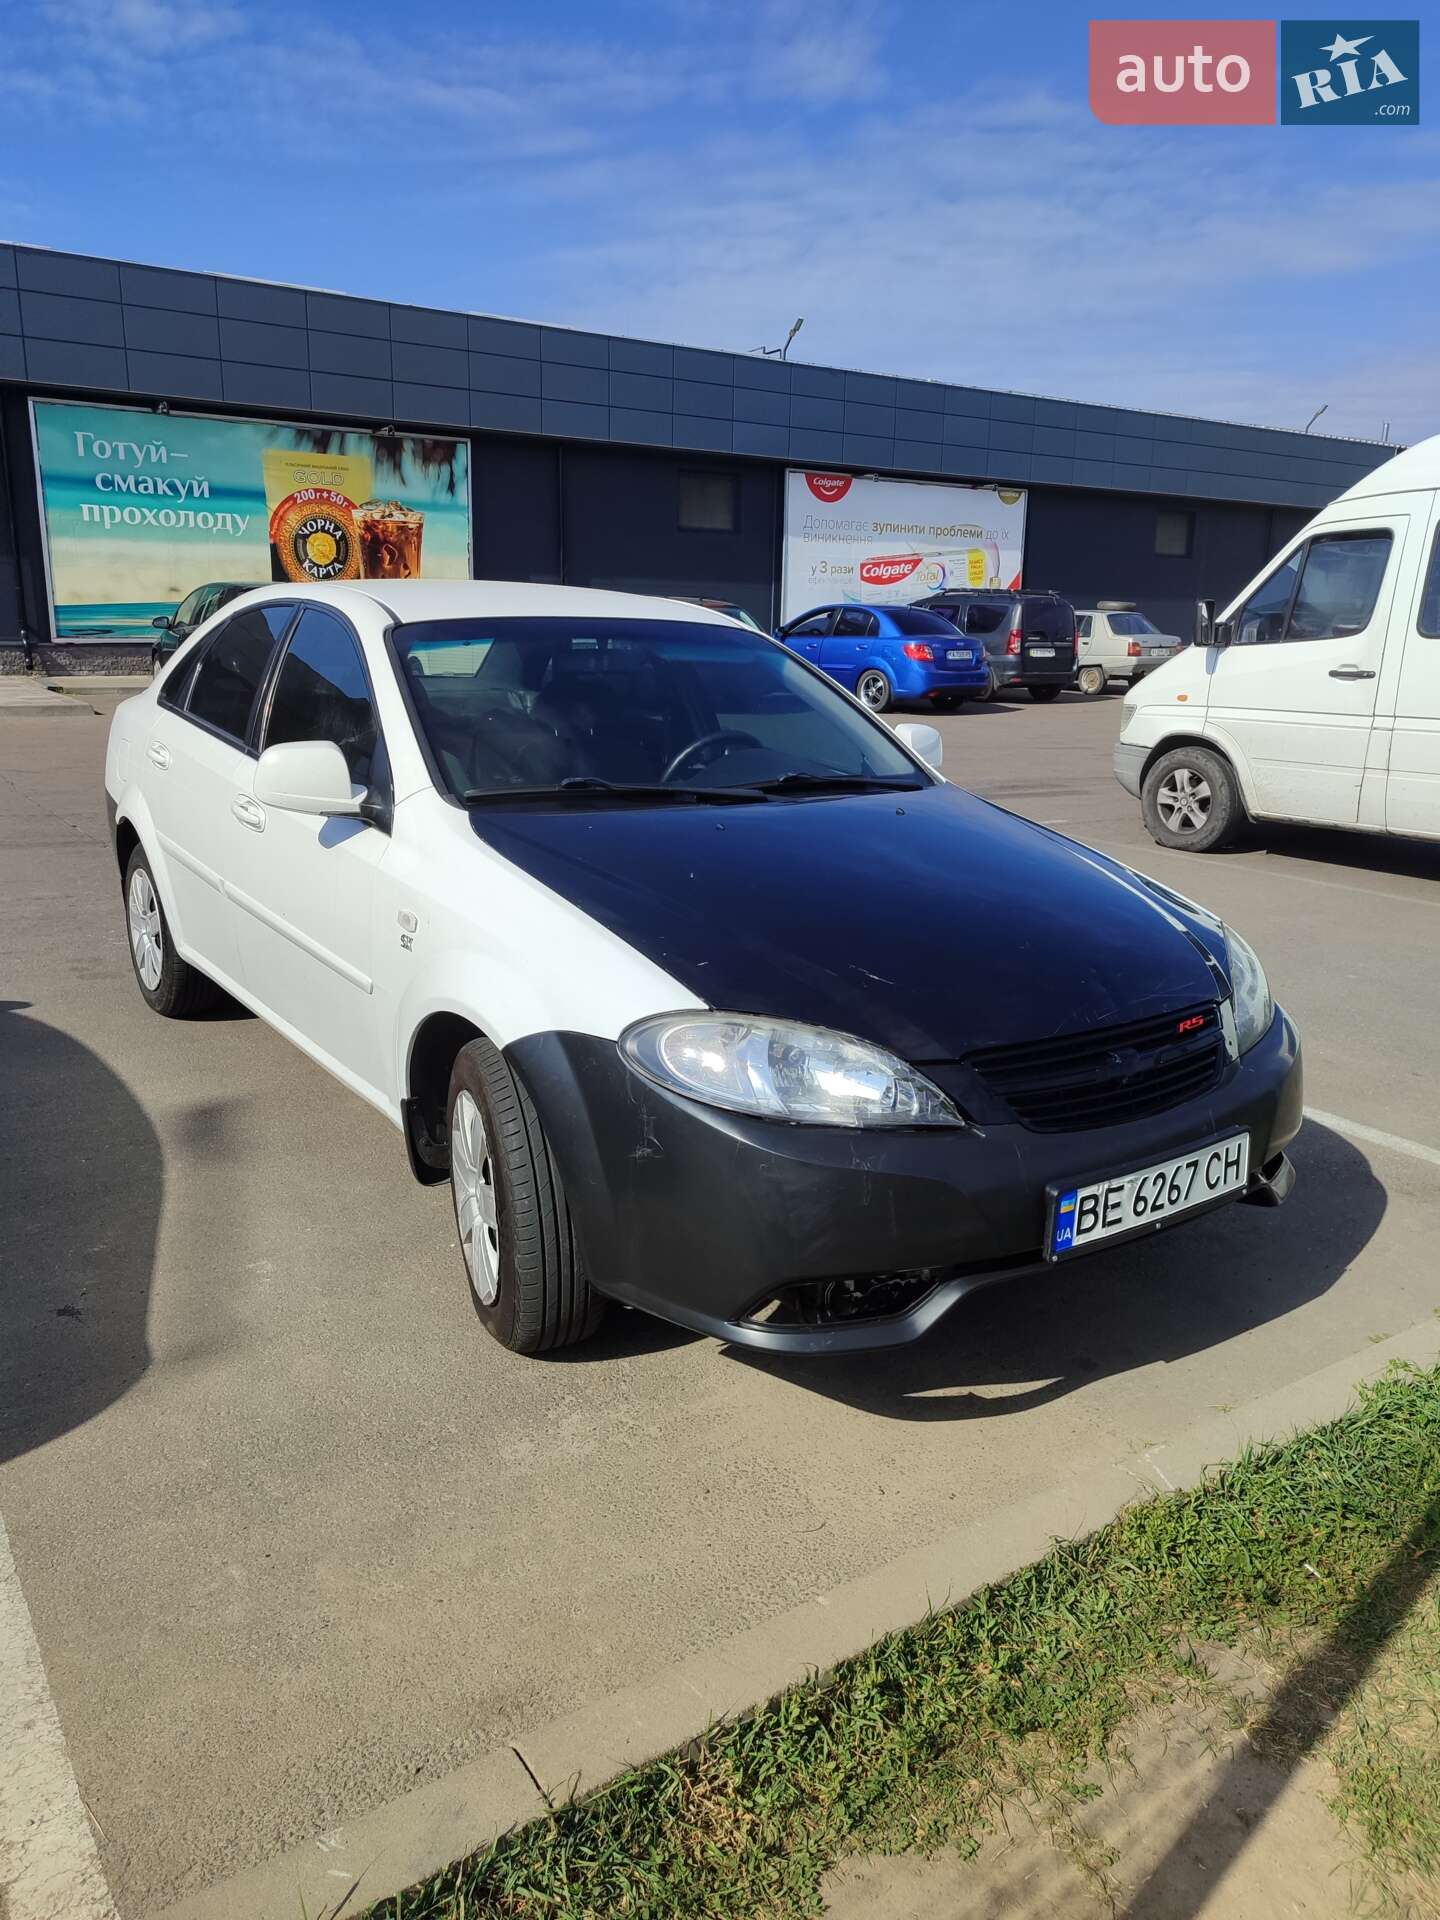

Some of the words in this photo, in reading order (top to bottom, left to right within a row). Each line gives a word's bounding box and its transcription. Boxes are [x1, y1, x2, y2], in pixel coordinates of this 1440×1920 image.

[95, 472, 210, 503] смакуй
[293, 470, 345, 487] GOLD
[813, 477, 845, 487] Colgate
[80, 503, 250, 537] прохолоду
[298, 518, 343, 540] ЧОРНА
[803, 514, 869, 532] Допомагає
[872, 521, 926, 535] зупинити
[929, 525, 983, 540] проблеми
[803, 532, 873, 545] виникнення
[302, 559, 344, 578] КАРТА
[820, 561, 828, 573] 3
[830, 565, 854, 575] рази
[862, 562, 914, 579] Colgate
[1178, 1015, 1204, 1033] RS
[1076, 1185, 1124, 1237] BE
[1133, 1160, 1199, 1218] 6267
[1205, 1143, 1242, 1190] CH
[1057, 1226, 1072, 1243] UA
